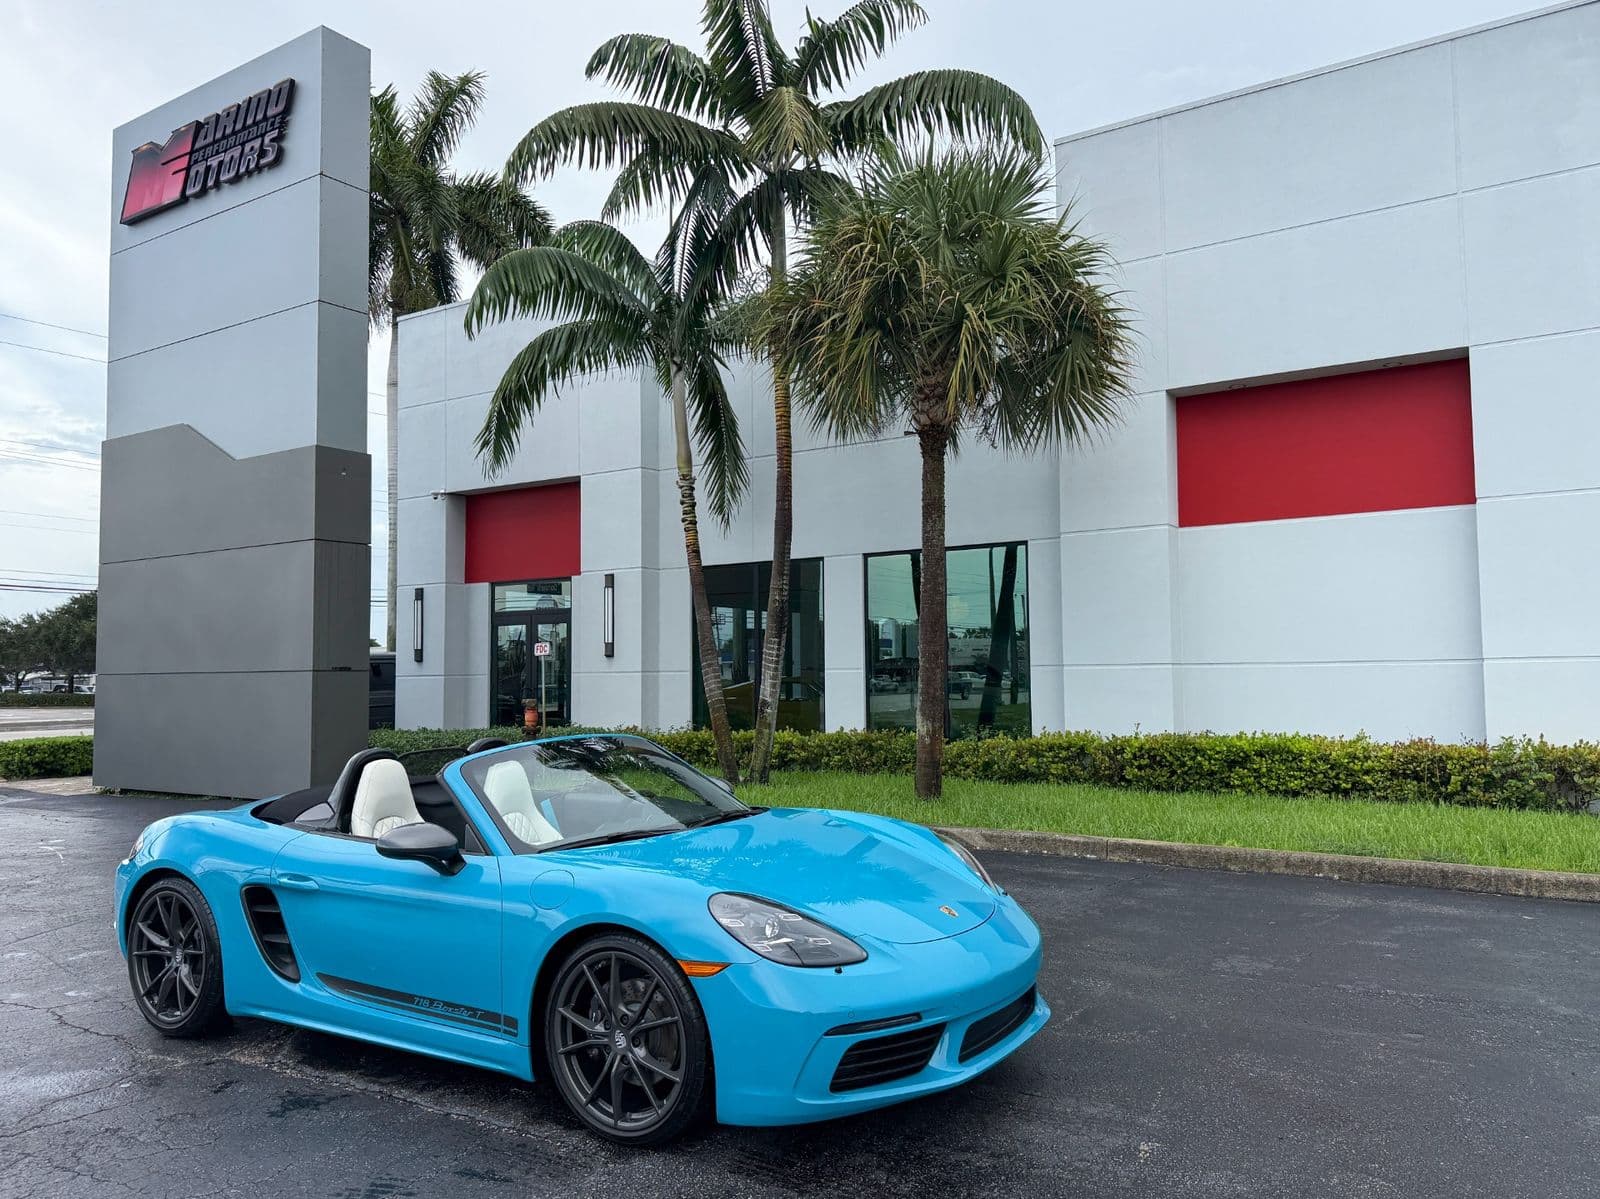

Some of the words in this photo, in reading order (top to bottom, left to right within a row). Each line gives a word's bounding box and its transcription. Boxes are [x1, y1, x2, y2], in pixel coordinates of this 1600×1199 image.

[191, 117, 284, 162] PERFORMANCE
[535, 644, 548, 654] FDC
[413, 996, 430, 1008] 718
[430, 1000, 474, 1017] Boxster
[475, 1010, 485, 1019] T
